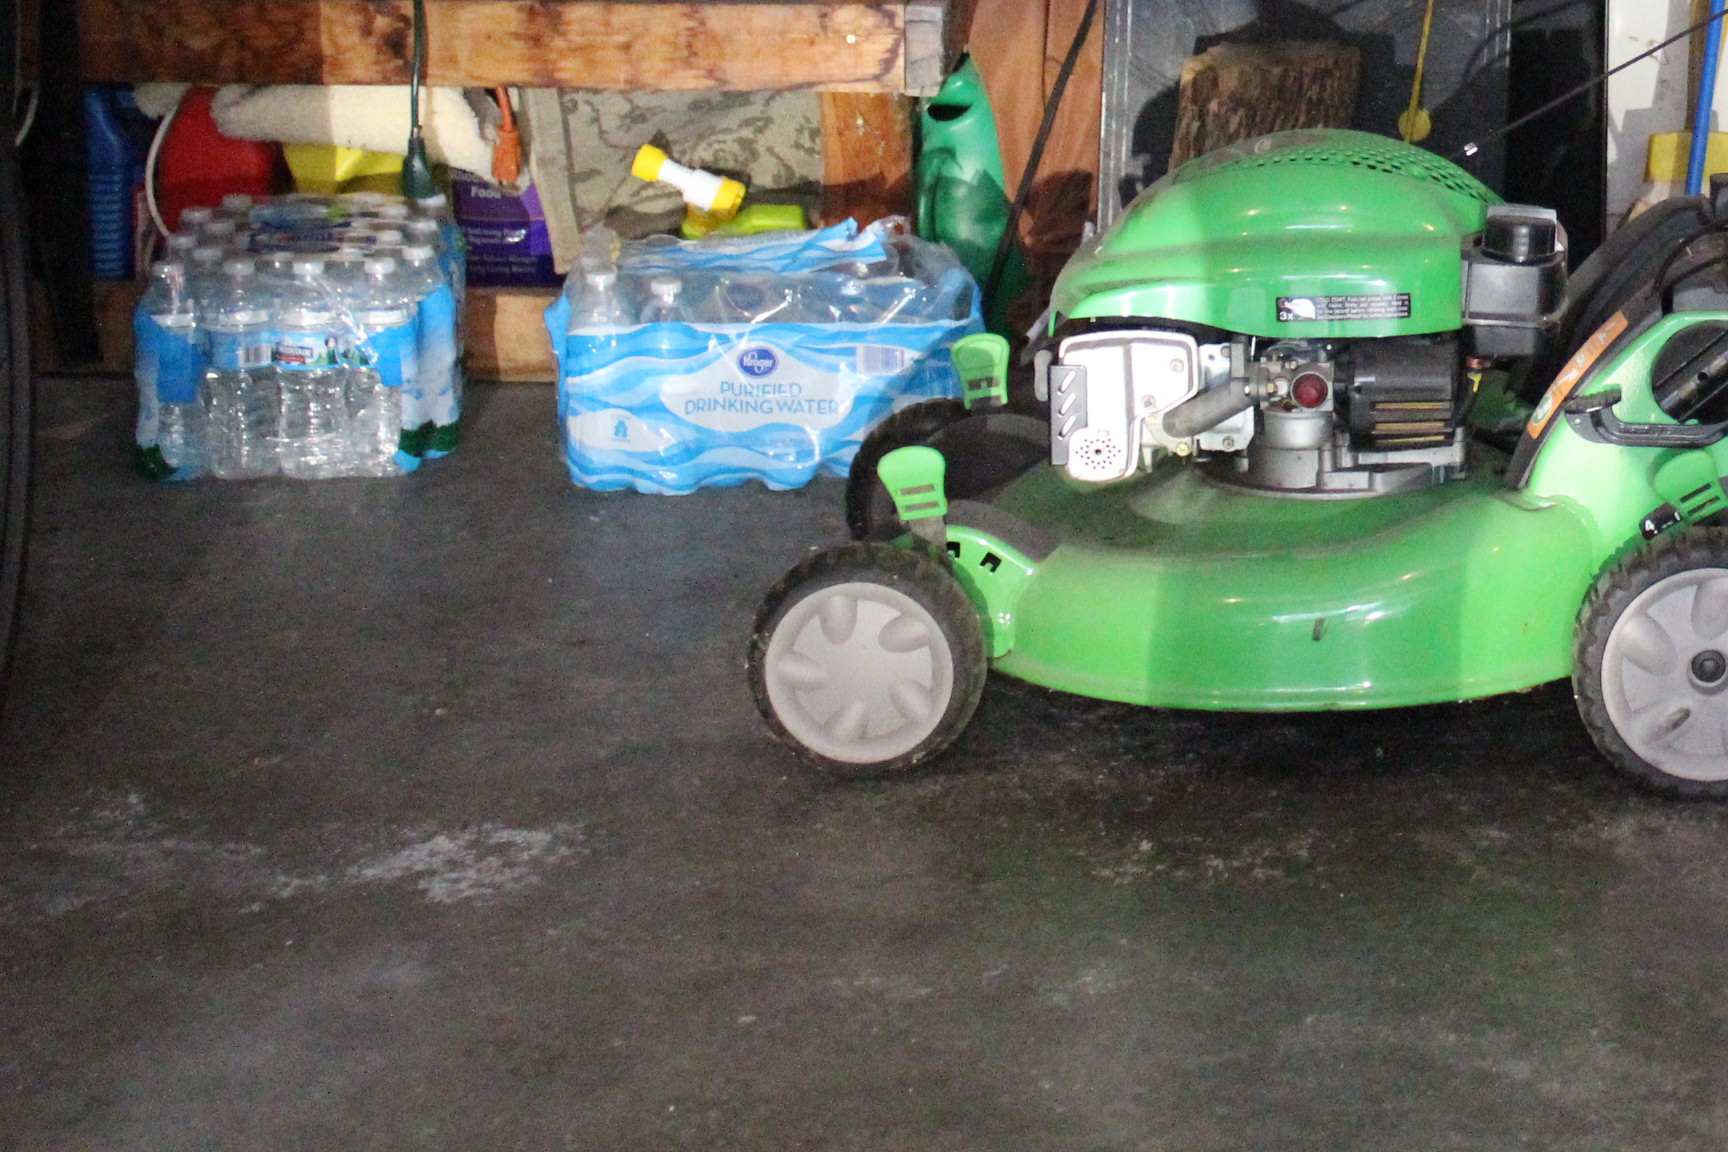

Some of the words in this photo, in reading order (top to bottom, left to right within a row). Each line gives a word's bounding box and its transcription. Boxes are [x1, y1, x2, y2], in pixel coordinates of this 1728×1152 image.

[1279, 311, 1294, 321] 3x
[743, 351, 774, 374] Kroger
[719, 381, 803, 398] PURIFIED
[685, 399, 774, 415] DRINKING
[776, 399, 839, 415] WATER
[1644, 519, 1656, 532] 4
